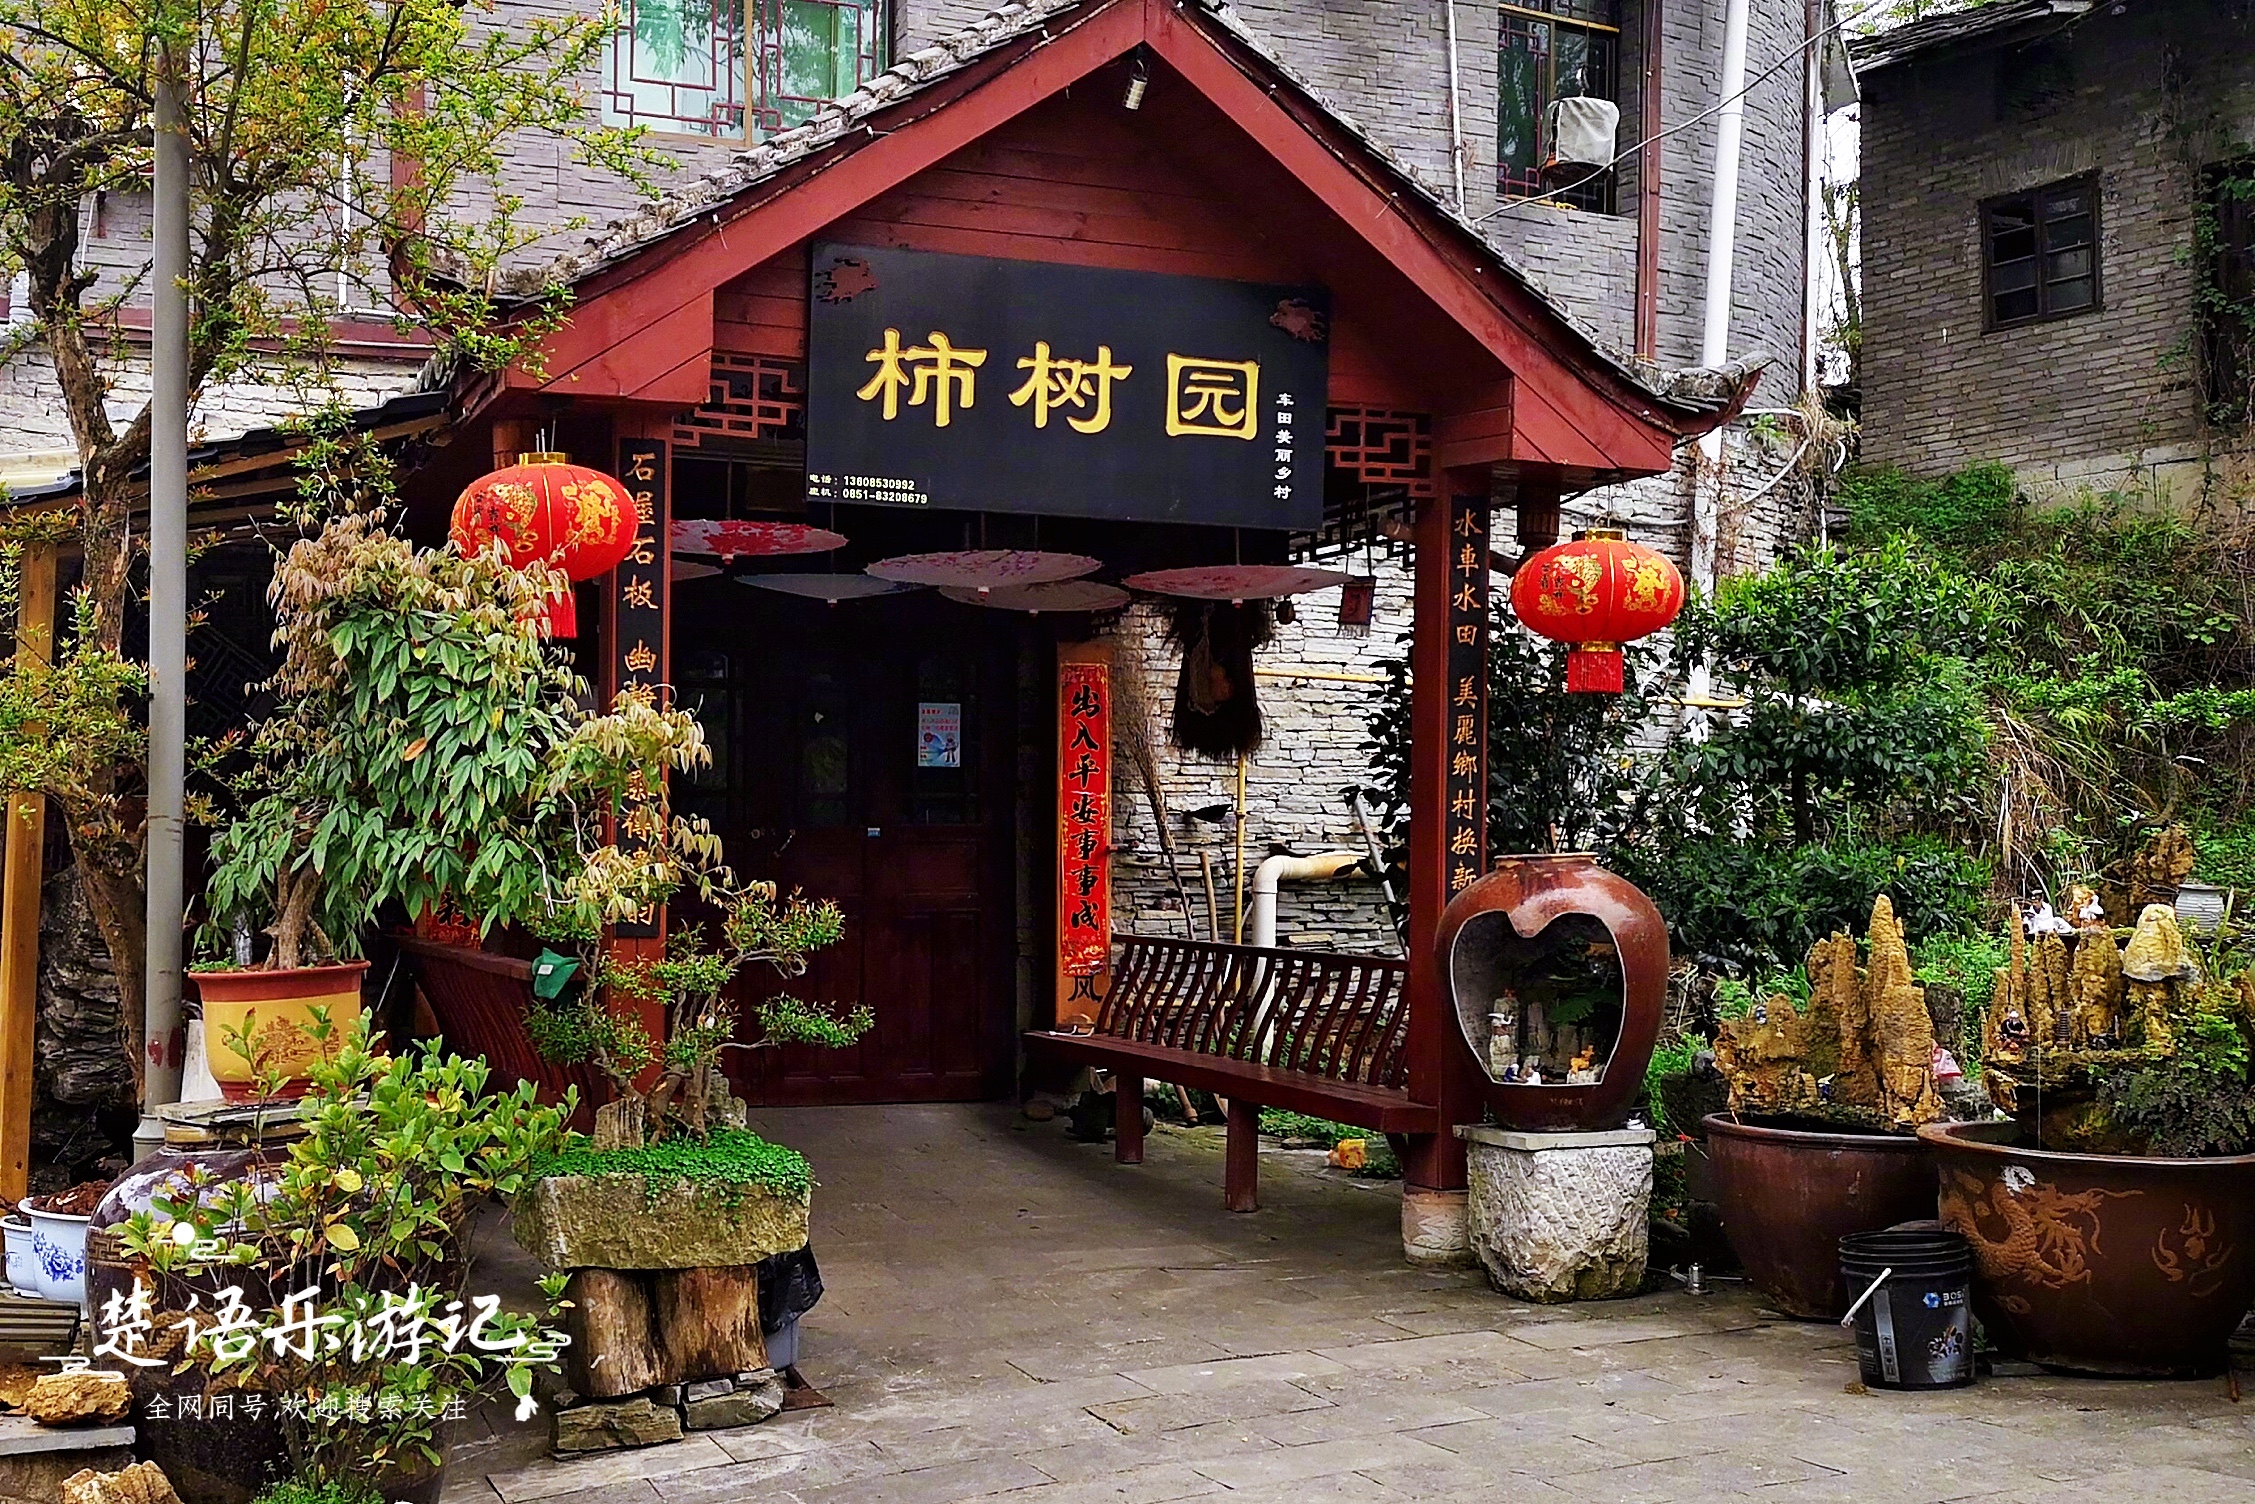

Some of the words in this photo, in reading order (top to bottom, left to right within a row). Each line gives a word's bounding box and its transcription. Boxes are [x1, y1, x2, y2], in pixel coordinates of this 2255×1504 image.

[855, 326, 1260, 441] 柿树园
[1273, 392, 1294, 500] 车田美丽乡村
[1068, 684, 1102, 931] 出入平安事事成
